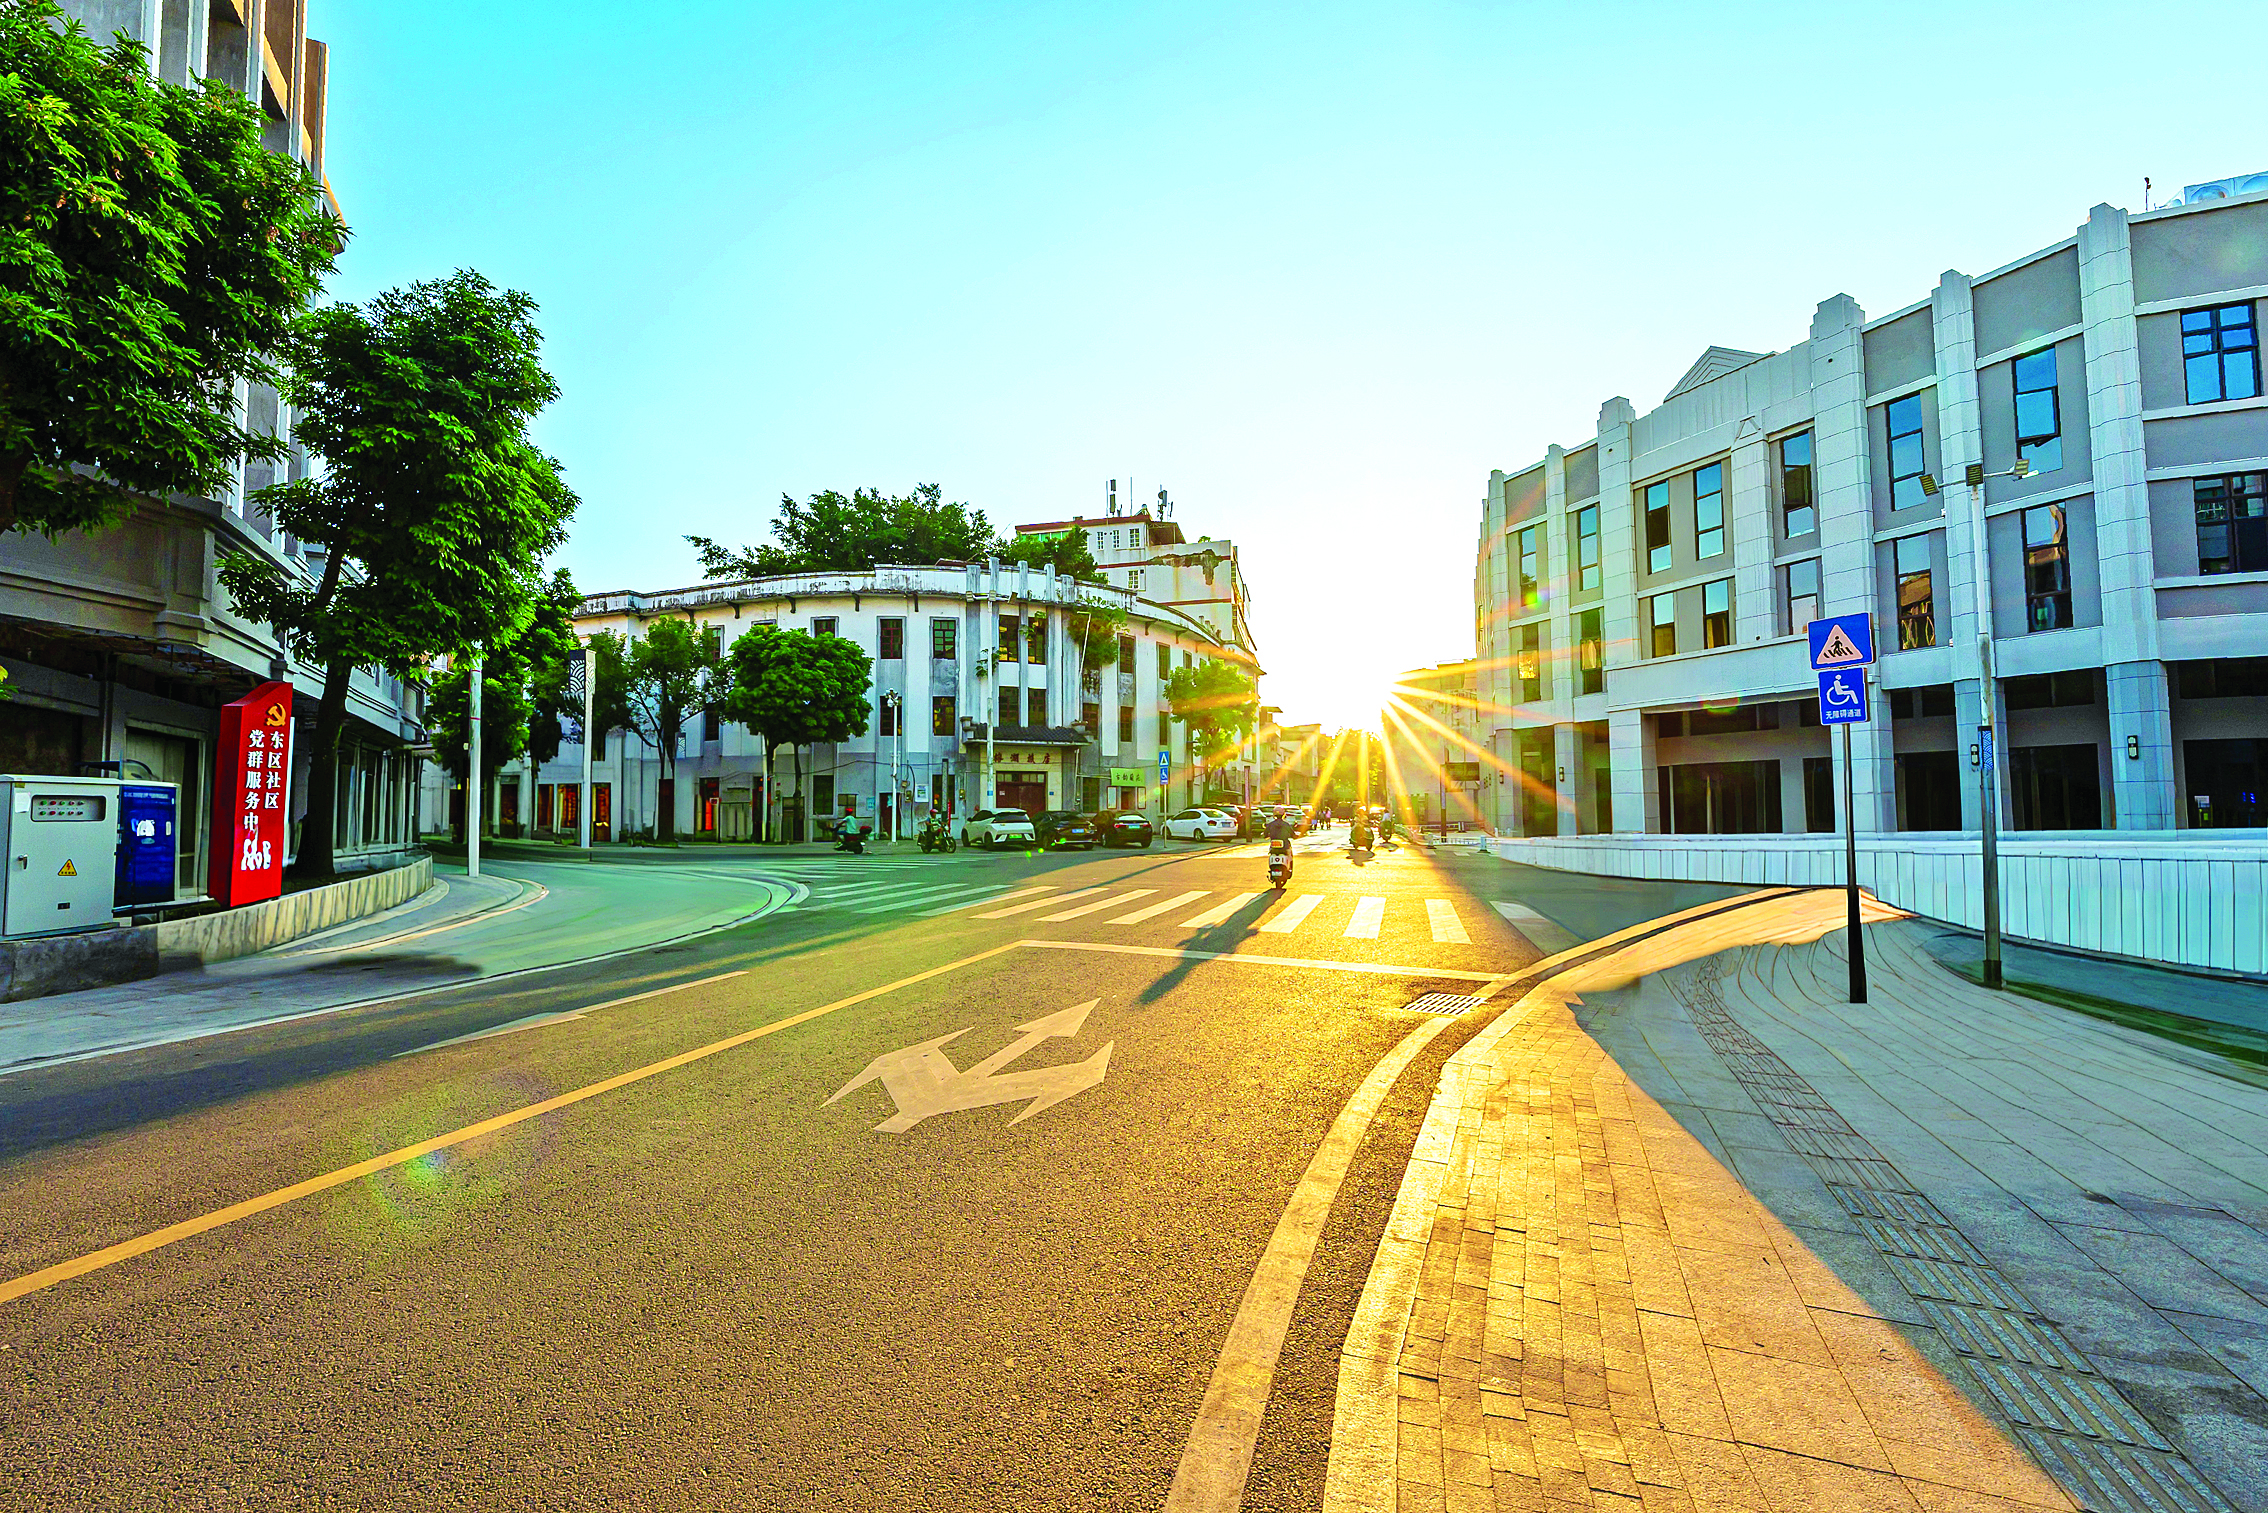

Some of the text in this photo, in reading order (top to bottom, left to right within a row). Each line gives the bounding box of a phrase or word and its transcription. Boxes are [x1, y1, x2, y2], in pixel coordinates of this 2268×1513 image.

[1825, 709, 1861, 719] 无障碍通道
[243, 729, 265, 851] 党群服务中
[264, 730, 285, 809] 东区社区
